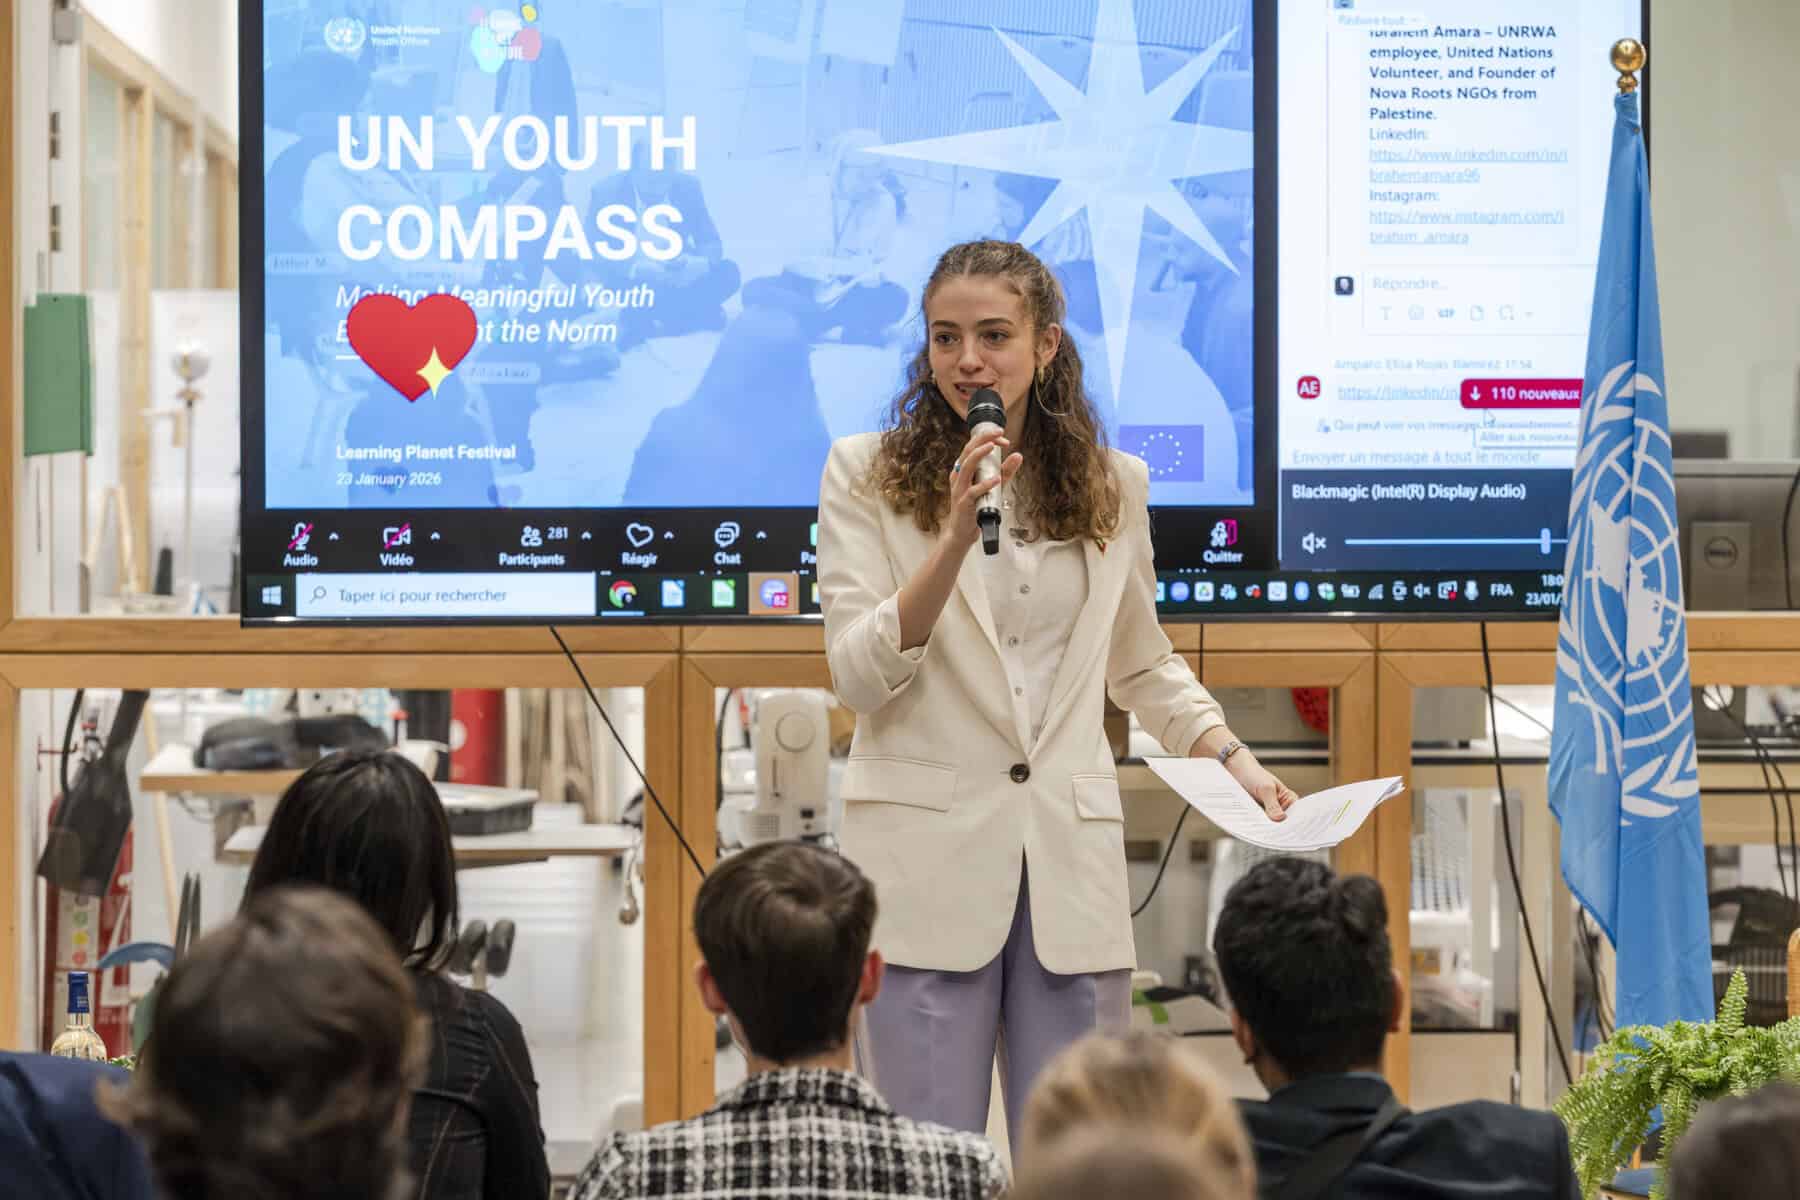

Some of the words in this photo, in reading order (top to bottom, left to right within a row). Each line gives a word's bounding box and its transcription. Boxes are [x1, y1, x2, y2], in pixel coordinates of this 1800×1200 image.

[1433, 25, 1480, 38] Amara
[1497, 25, 1557, 38] UNRWA
[1369, 46, 1442, 62] employee,
[1446, 46, 1494, 59] United
[1499, 46, 1554, 59] Nations
[1369, 67, 1443, 80] Volunteer,
[1447, 66, 1473, 79] and
[1478, 67, 1536, 79] Founder
[1541, 66, 1556, 79] of
[1369, 87, 1407, 100] Nova
[1412, 87, 1452, 100] Roots
[1457, 87, 1498, 100] NGOs
[1502, 87, 1538, 100] from
[1369, 107, 1438, 121] Palestine.
[337, 115, 434, 171] UN
[456, 115, 698, 171] YOUTH
[337, 204, 684, 261] COMPASS
[585, 284, 655, 308] Youth
[501, 318, 543, 343] the
[547, 318, 618, 343] Norm
[1298, 380, 1319, 395] AE
[1491, 387, 1516, 400] 110
[1518, 389, 1580, 400] nouveaux
[336, 444, 402, 462] Learning
[406, 444, 453, 460] Planet
[457, 444, 516, 460] Festival
[1349, 454, 1366, 464] un
[1369, 453, 1429, 467] message
[336, 471, 352, 486] 23
[354, 471, 407, 490] January
[410, 471, 442, 486] 2026
[1292, 483, 1368, 501] Blackmagic
[1372, 483, 1425, 501] (Intel(R)
[1428, 483, 1478, 501] Display
[1480, 483, 1527, 500] Audio)
[547, 526, 569, 540] 281
[283, 552, 319, 567] Audio
[379, 551, 414, 567] Vidéo
[499, 551, 566, 569] Participants
[621, 551, 658, 569] Réagir
[713, 551, 742, 566] Chat
[1202, 549, 1243, 564] Quitter
[338, 587, 373, 605] Taper
[377, 587, 397, 602] ici
[400, 590, 431, 605] pour
[434, 586, 508, 602] rechercher
[1490, 582, 1514, 597] FRA
